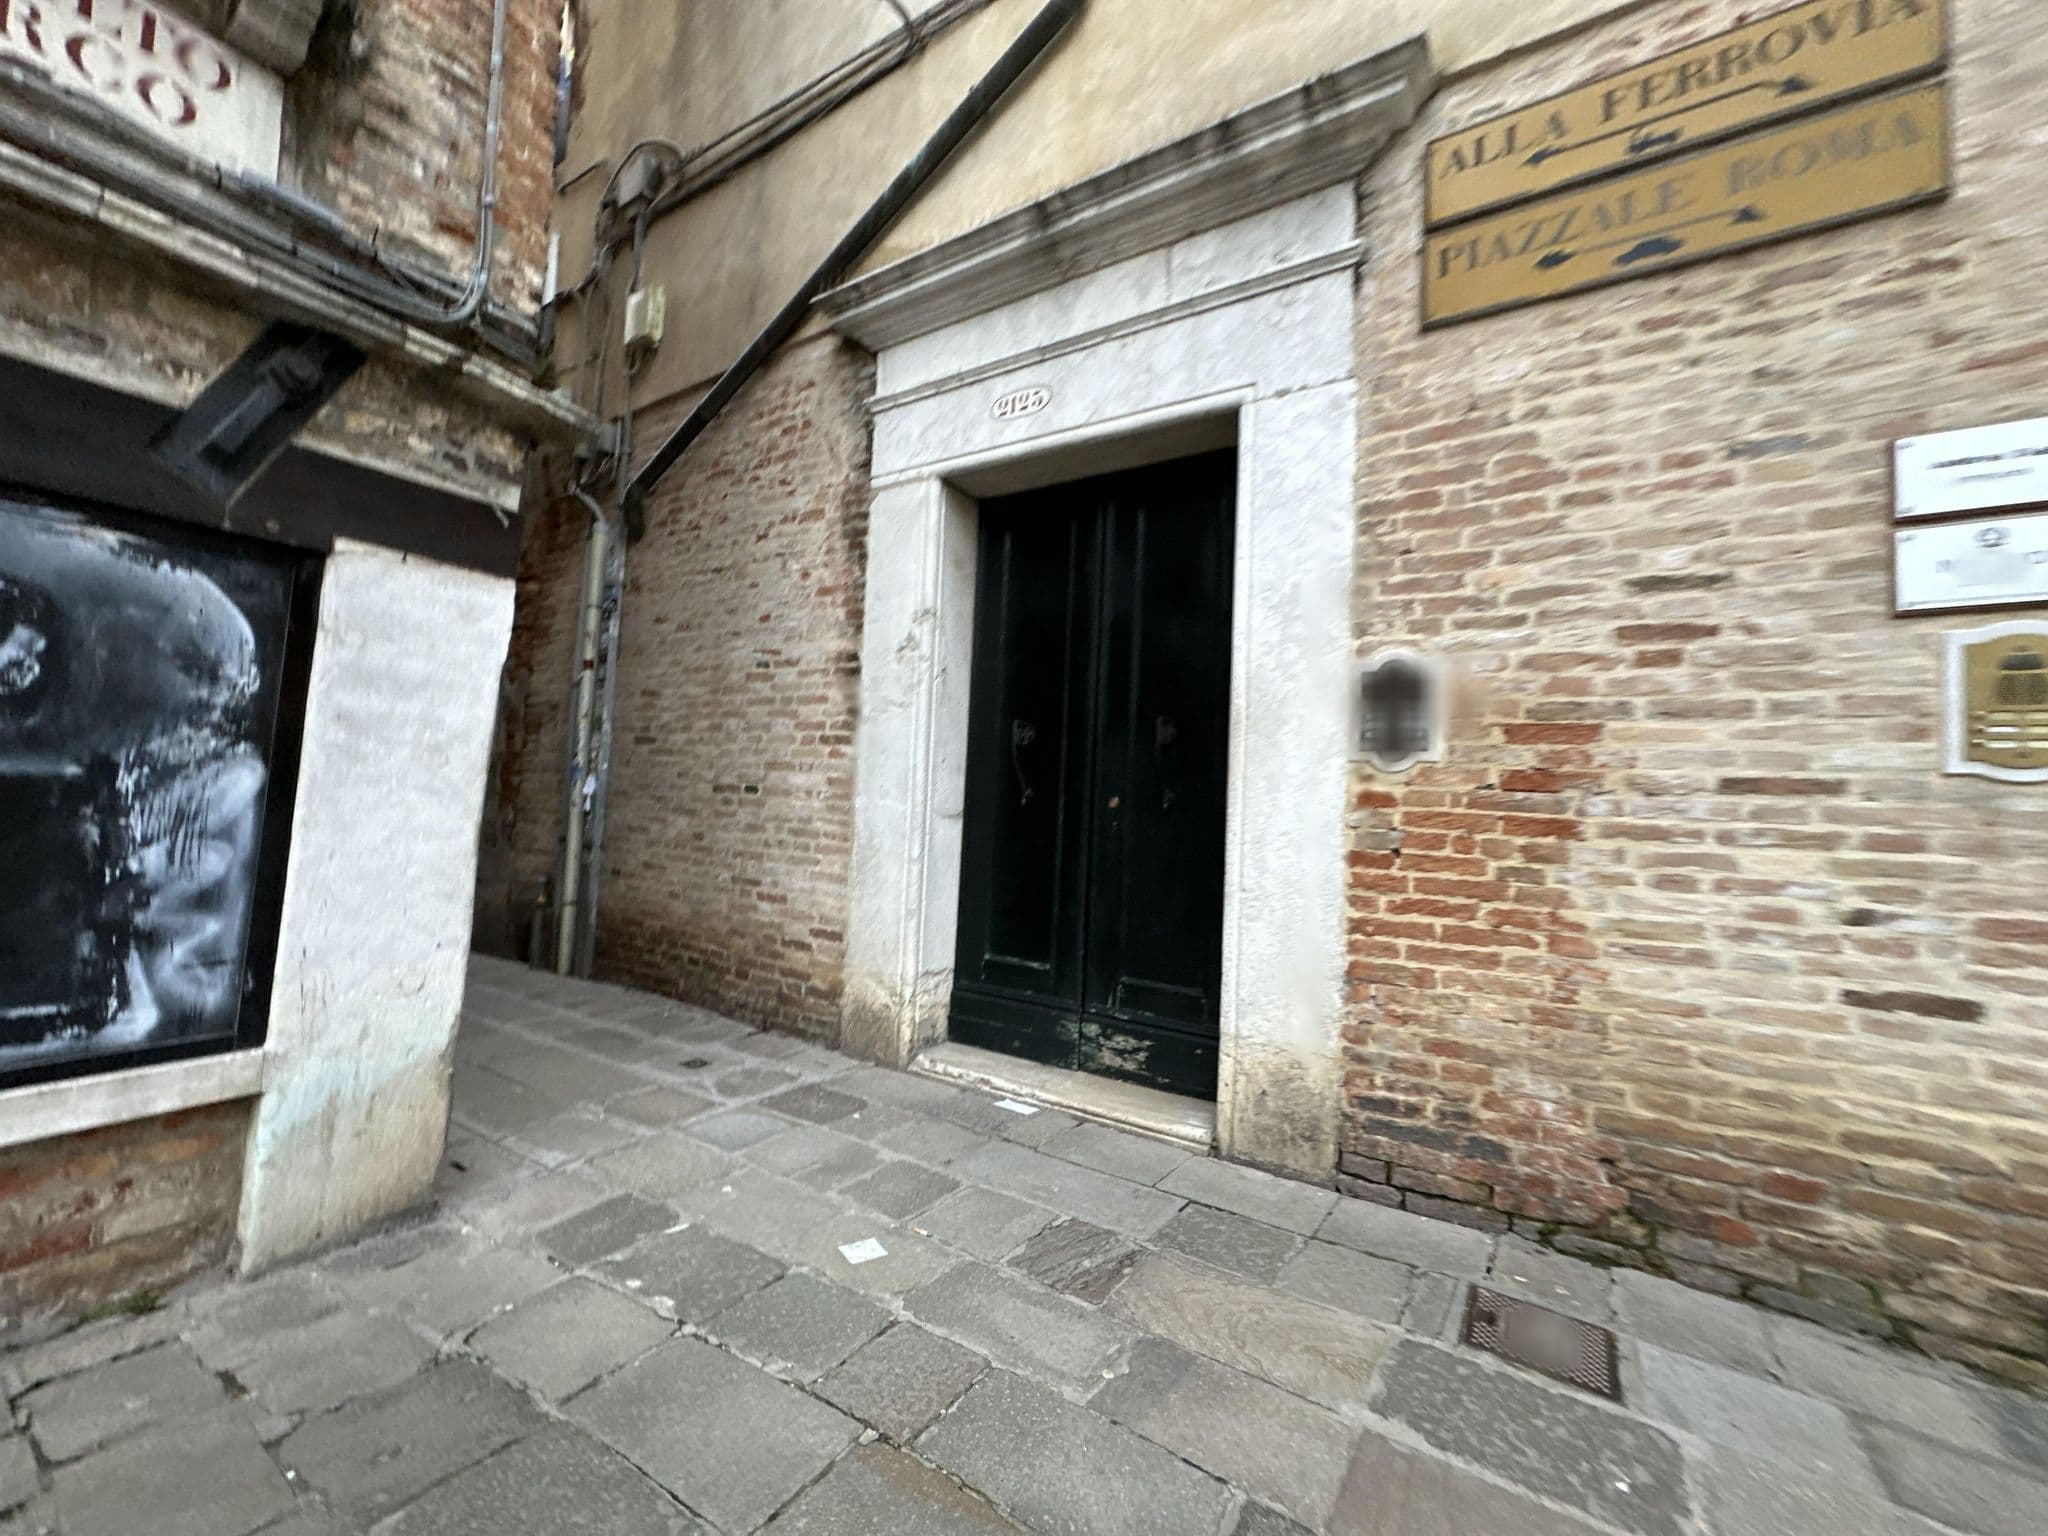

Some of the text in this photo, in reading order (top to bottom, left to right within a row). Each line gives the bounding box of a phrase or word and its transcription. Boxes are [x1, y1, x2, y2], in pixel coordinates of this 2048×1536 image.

[1439, 110, 1571, 179] ALLA
[1437, 111, 1922, 279] PIAZZALE ROMA
[998, 389, 1044, 418] 2125
